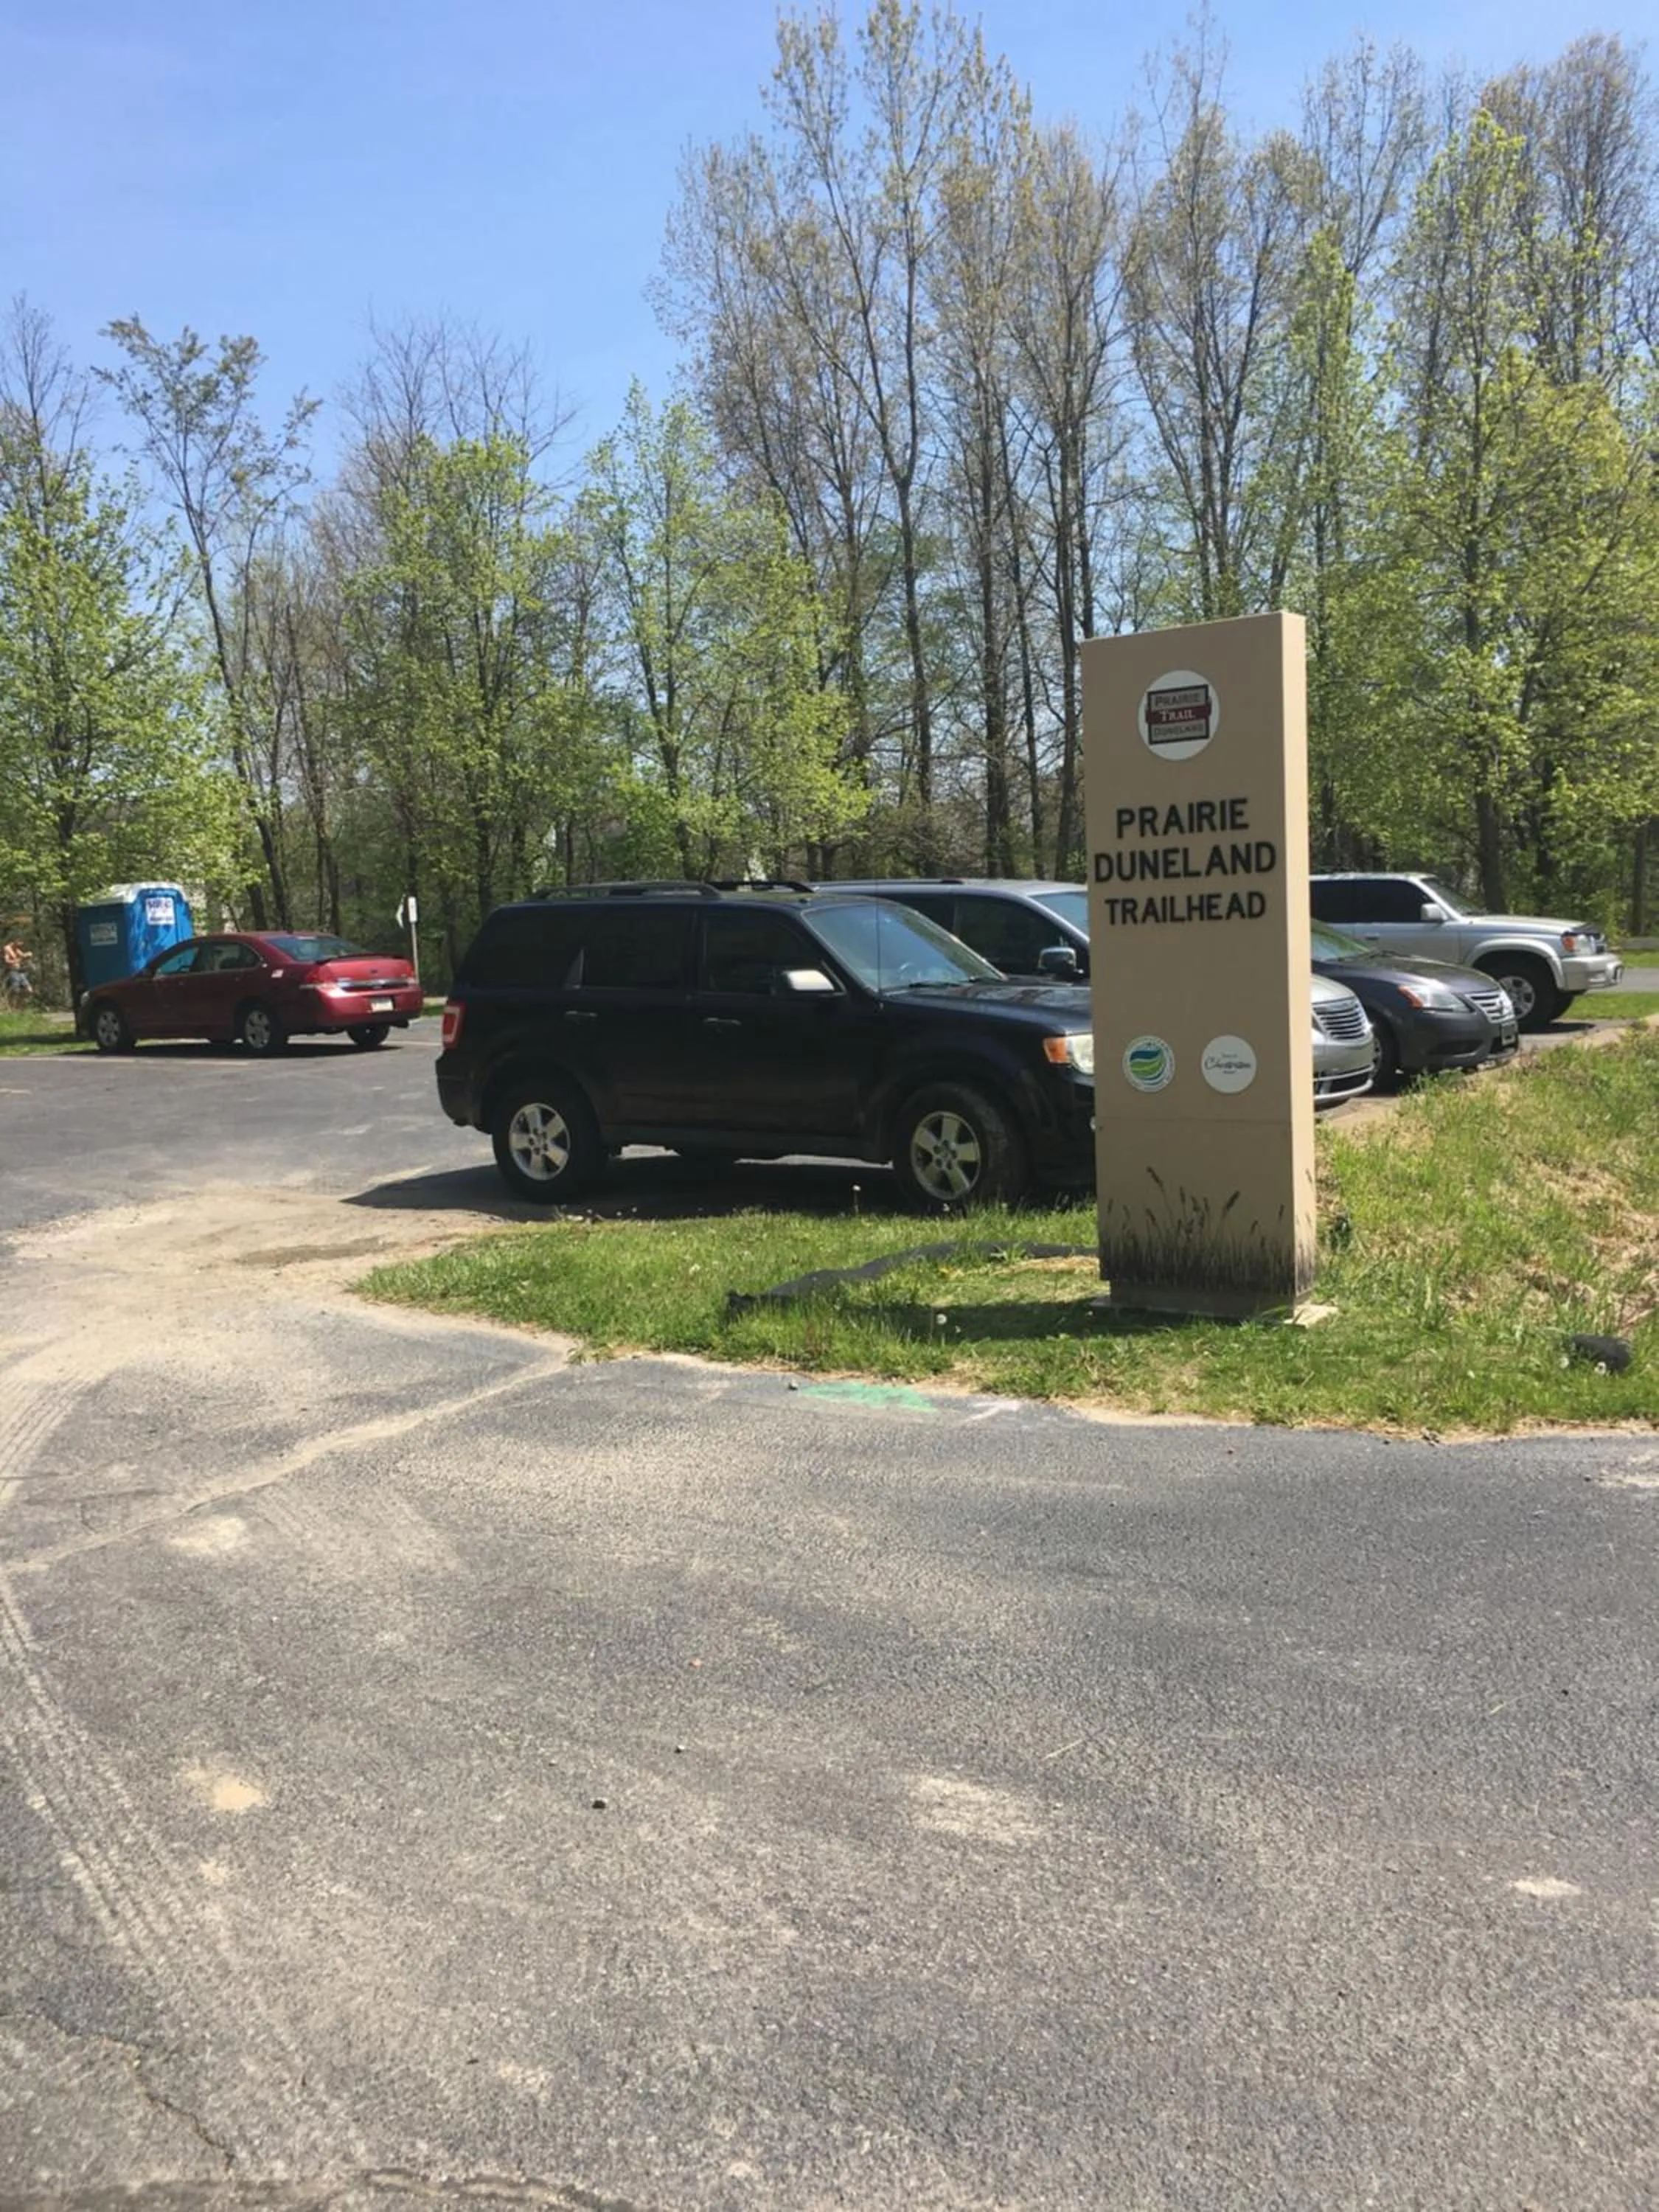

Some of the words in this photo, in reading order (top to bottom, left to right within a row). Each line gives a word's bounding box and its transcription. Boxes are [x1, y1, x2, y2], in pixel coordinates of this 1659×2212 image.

[1159, 709, 1196, 722] TRAIL
[1116, 797, 1251, 839] PRAIRIE
[1093, 841, 1276, 883] DUNELAND
[1104, 891, 1267, 926] TRAILHEAD
